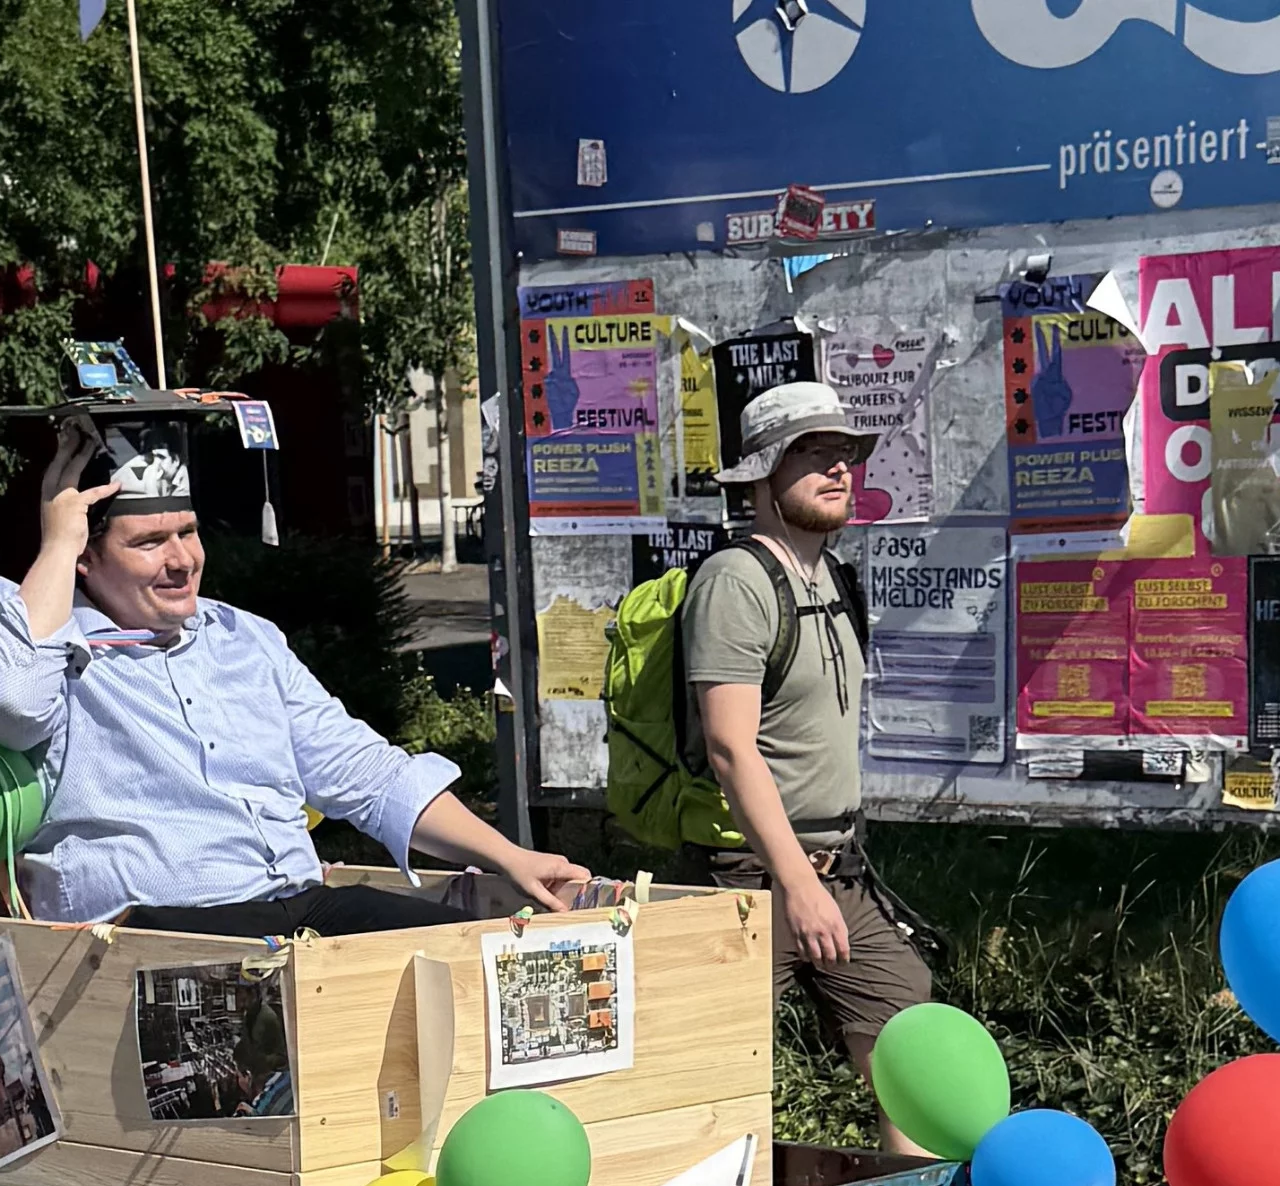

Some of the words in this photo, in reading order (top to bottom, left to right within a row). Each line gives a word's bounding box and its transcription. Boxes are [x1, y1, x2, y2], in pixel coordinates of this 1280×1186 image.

[1058, 118, 1251, 190] präsentiert
[1008, 284, 1083, 309] YOUTH
[575, 321, 652, 344] CULTURE
[730, 344, 759, 367] THE
[763, 339, 801, 364] LAST
[747, 364, 786, 389] MILE
[838, 371, 889, 387] PUBQUIZ
[849, 393, 896, 407] QUEERS
[576, 408, 655, 430] FESTIVAL
[853, 413, 904, 428] FRIENDS
[532, 444, 583, 456] POWER
[586, 442, 632, 455] PLUSH
[533, 457, 600, 473] REEZA
[1014, 451, 1075, 467] POWER
[1015, 467, 1095, 486] REEZA
[648, 531, 676, 550] THE
[679, 529, 715, 551] LAST
[871, 566, 1002, 589] MISSSTANDS
[1137, 581, 1165, 593] LUST
[1168, 579, 1208, 592] SELBST
[871, 587, 955, 609] MELDER
[1023, 584, 1048, 595] LUST
[1137, 596, 1152, 608] ZU
